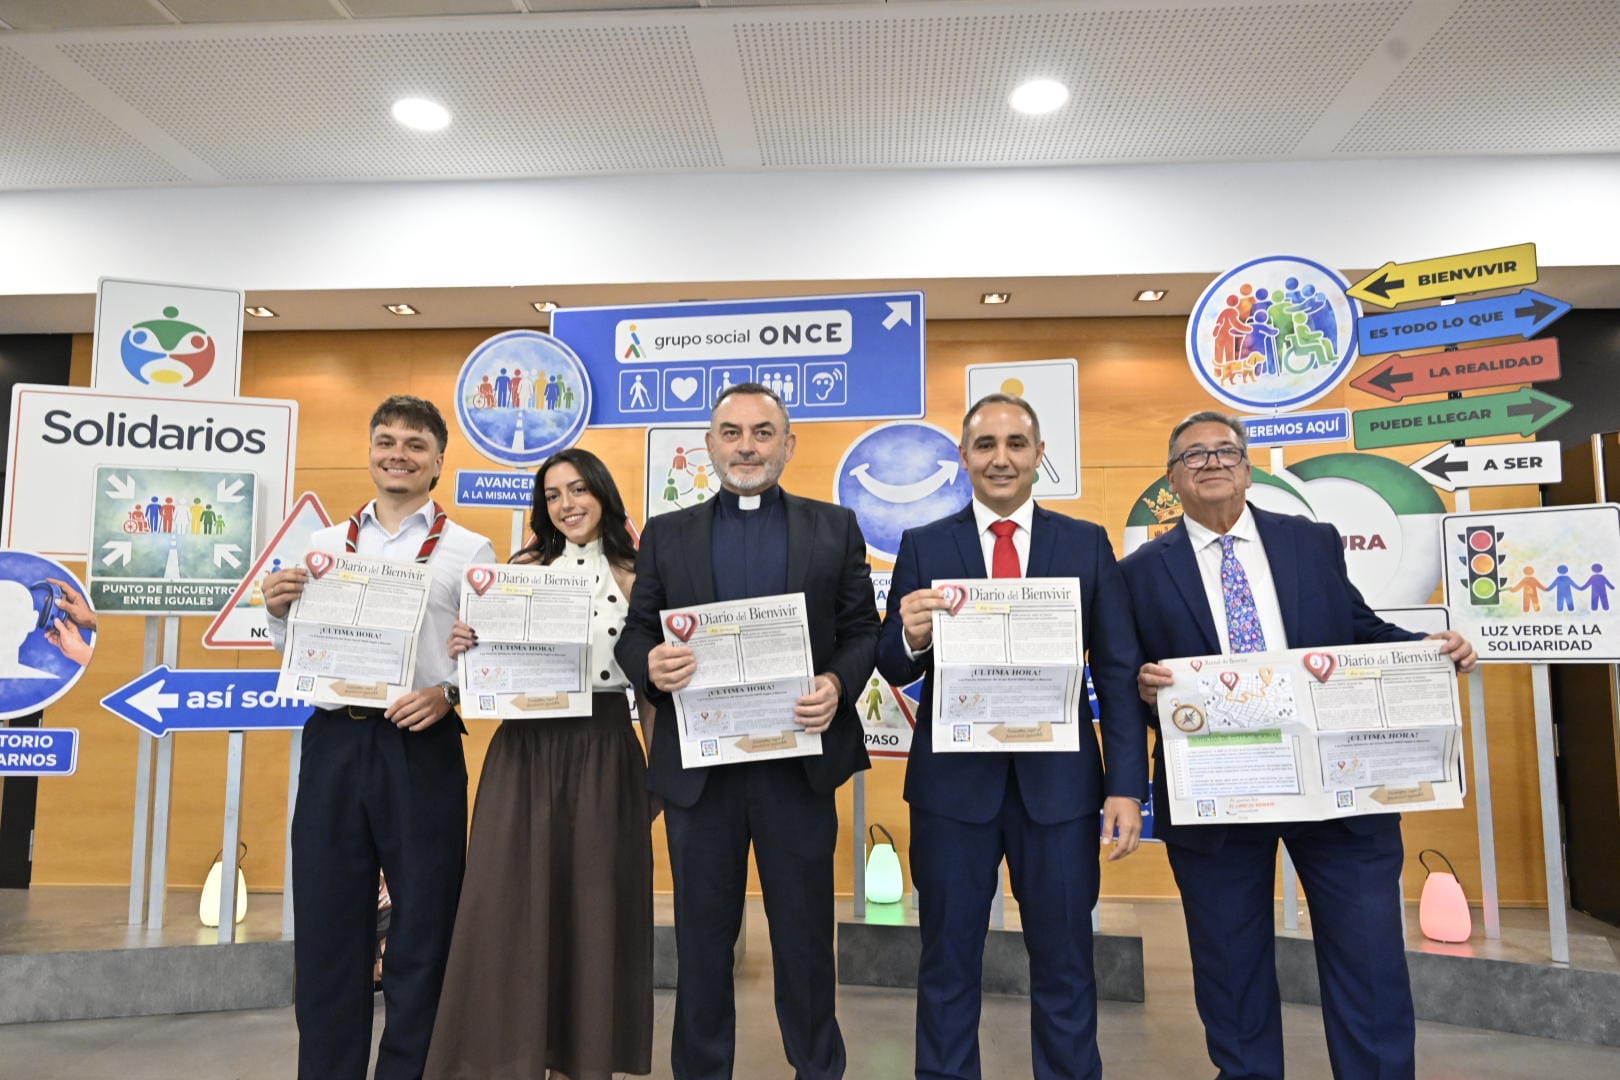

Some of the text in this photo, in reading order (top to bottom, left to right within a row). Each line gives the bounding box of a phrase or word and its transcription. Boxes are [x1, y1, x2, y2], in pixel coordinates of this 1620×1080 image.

[1418, 261, 1517, 286] BIENVIVIR
[1369, 311, 1504, 339] ES TODO LO QUE
[654, 322, 843, 350] grupo social ONCE
[1429, 354, 1544, 378] LA REALIDAD
[1305, 416, 1340, 434] AQUÍ
[1370, 408, 1492, 432] PUEDE LLEGAR
[42, 409, 266, 454] Solidarios
[1483, 456, 1543, 471] A SER
[462, 490, 469, 499] A
[471, 491, 483, 500] LA
[487, 491, 517, 500] MISMA
[336, 558, 368, 573] Diario
[369, 567, 379, 575] del
[381, 564, 426, 581] Bienvivir
[497, 571, 589, 587] Diario del Bienvivir
[102, 584, 237, 596] PUNTO DE ENCUENTRO
[970, 587, 1072, 601] Diario del Bienvivir
[123, 595, 214, 606] ENTRE IGUALES
[698, 604, 798, 626] Diario del Bienvivir
[1481, 624, 1602, 637] LUZ VERDE A LA
[1488, 640, 1593, 651] SOLIDARIDAD
[1338, 649, 1443, 668] Diario del Bienvivir
[186, 685, 233, 709] así
[864, 734, 899, 746] PASO
